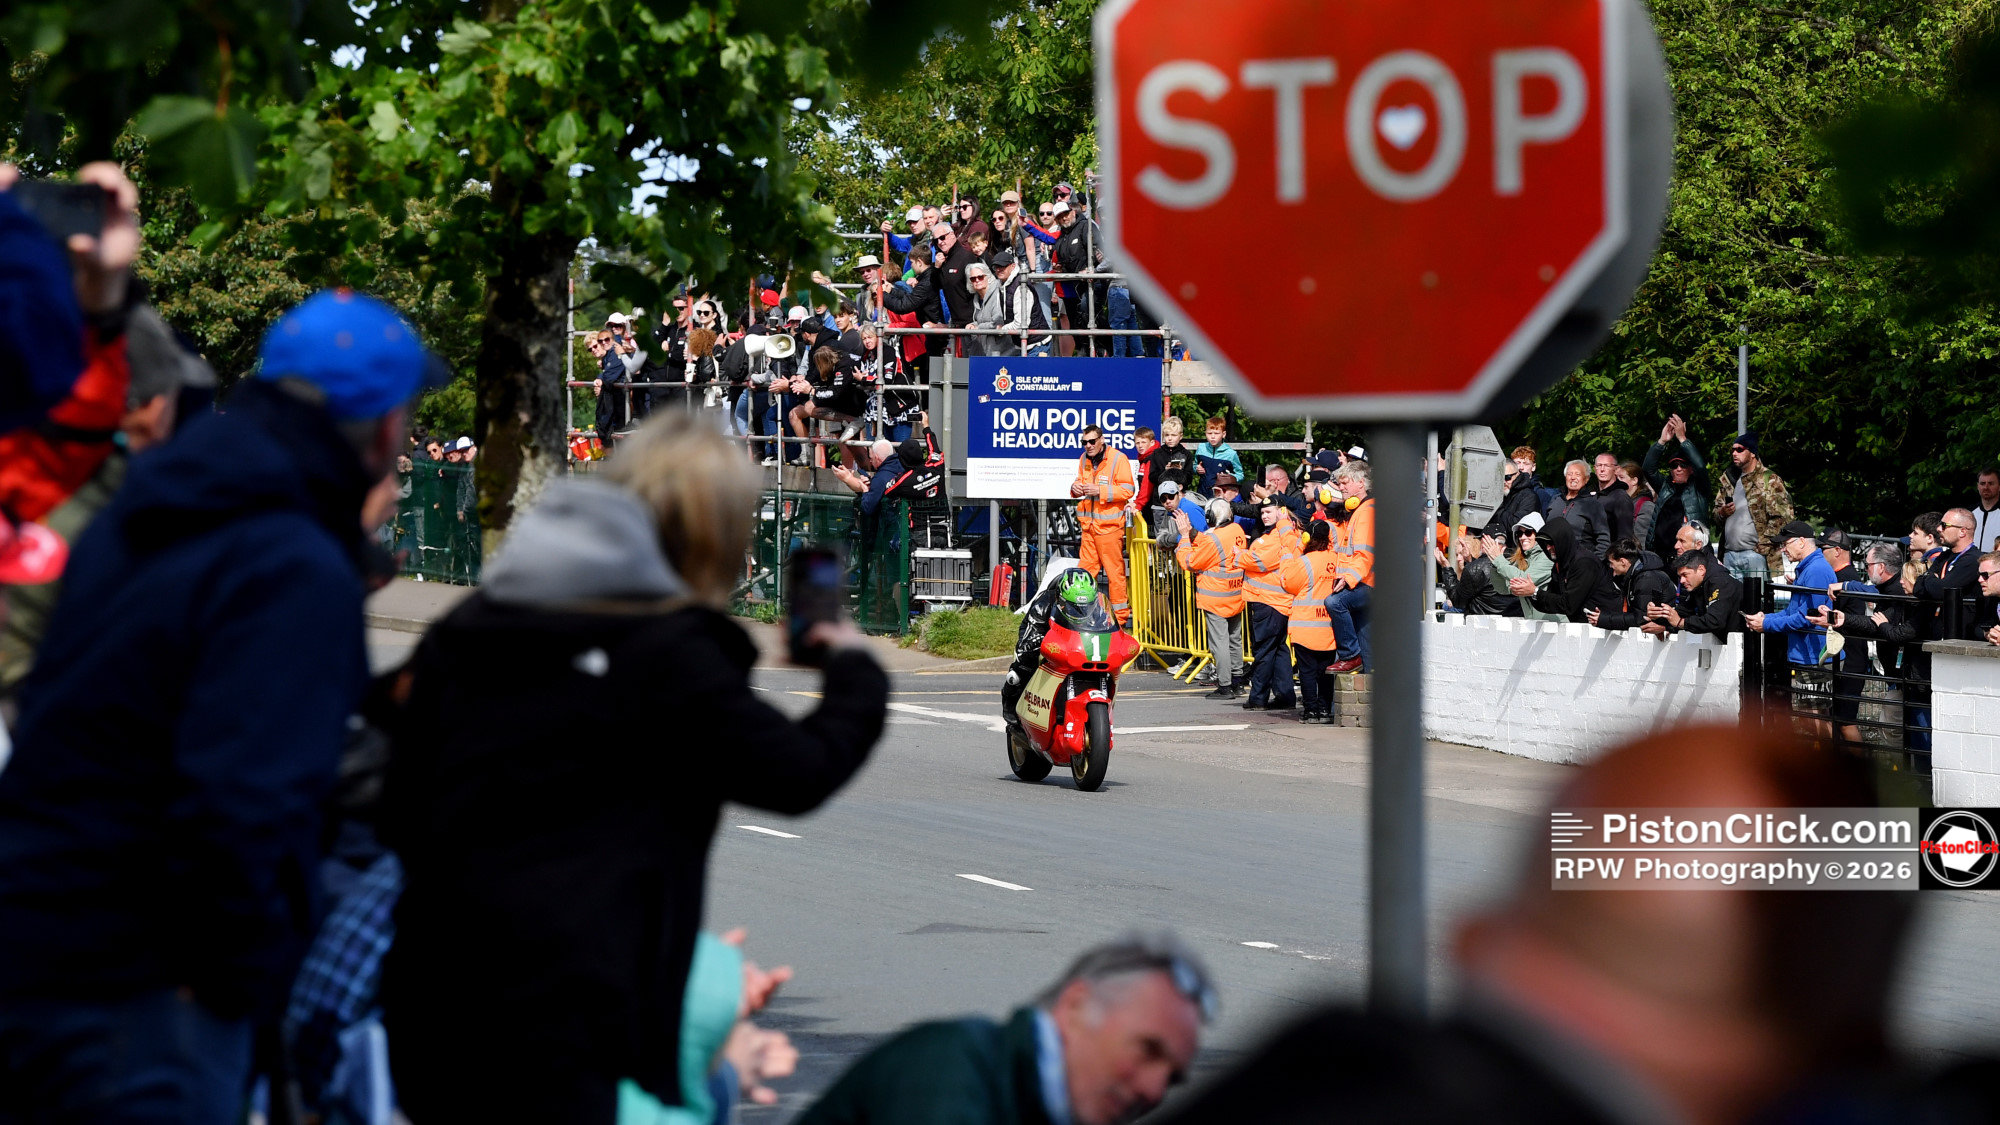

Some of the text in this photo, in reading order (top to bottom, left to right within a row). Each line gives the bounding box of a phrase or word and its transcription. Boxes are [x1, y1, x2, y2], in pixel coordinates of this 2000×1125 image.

[1135, 47, 1589, 210] STOP
[1042, 376, 1059, 384] MAN
[993, 407, 1136, 431] IOM POLICE
[992, 432, 1136, 449] HEADQUAERS
[1091, 635, 1102, 662] 1
